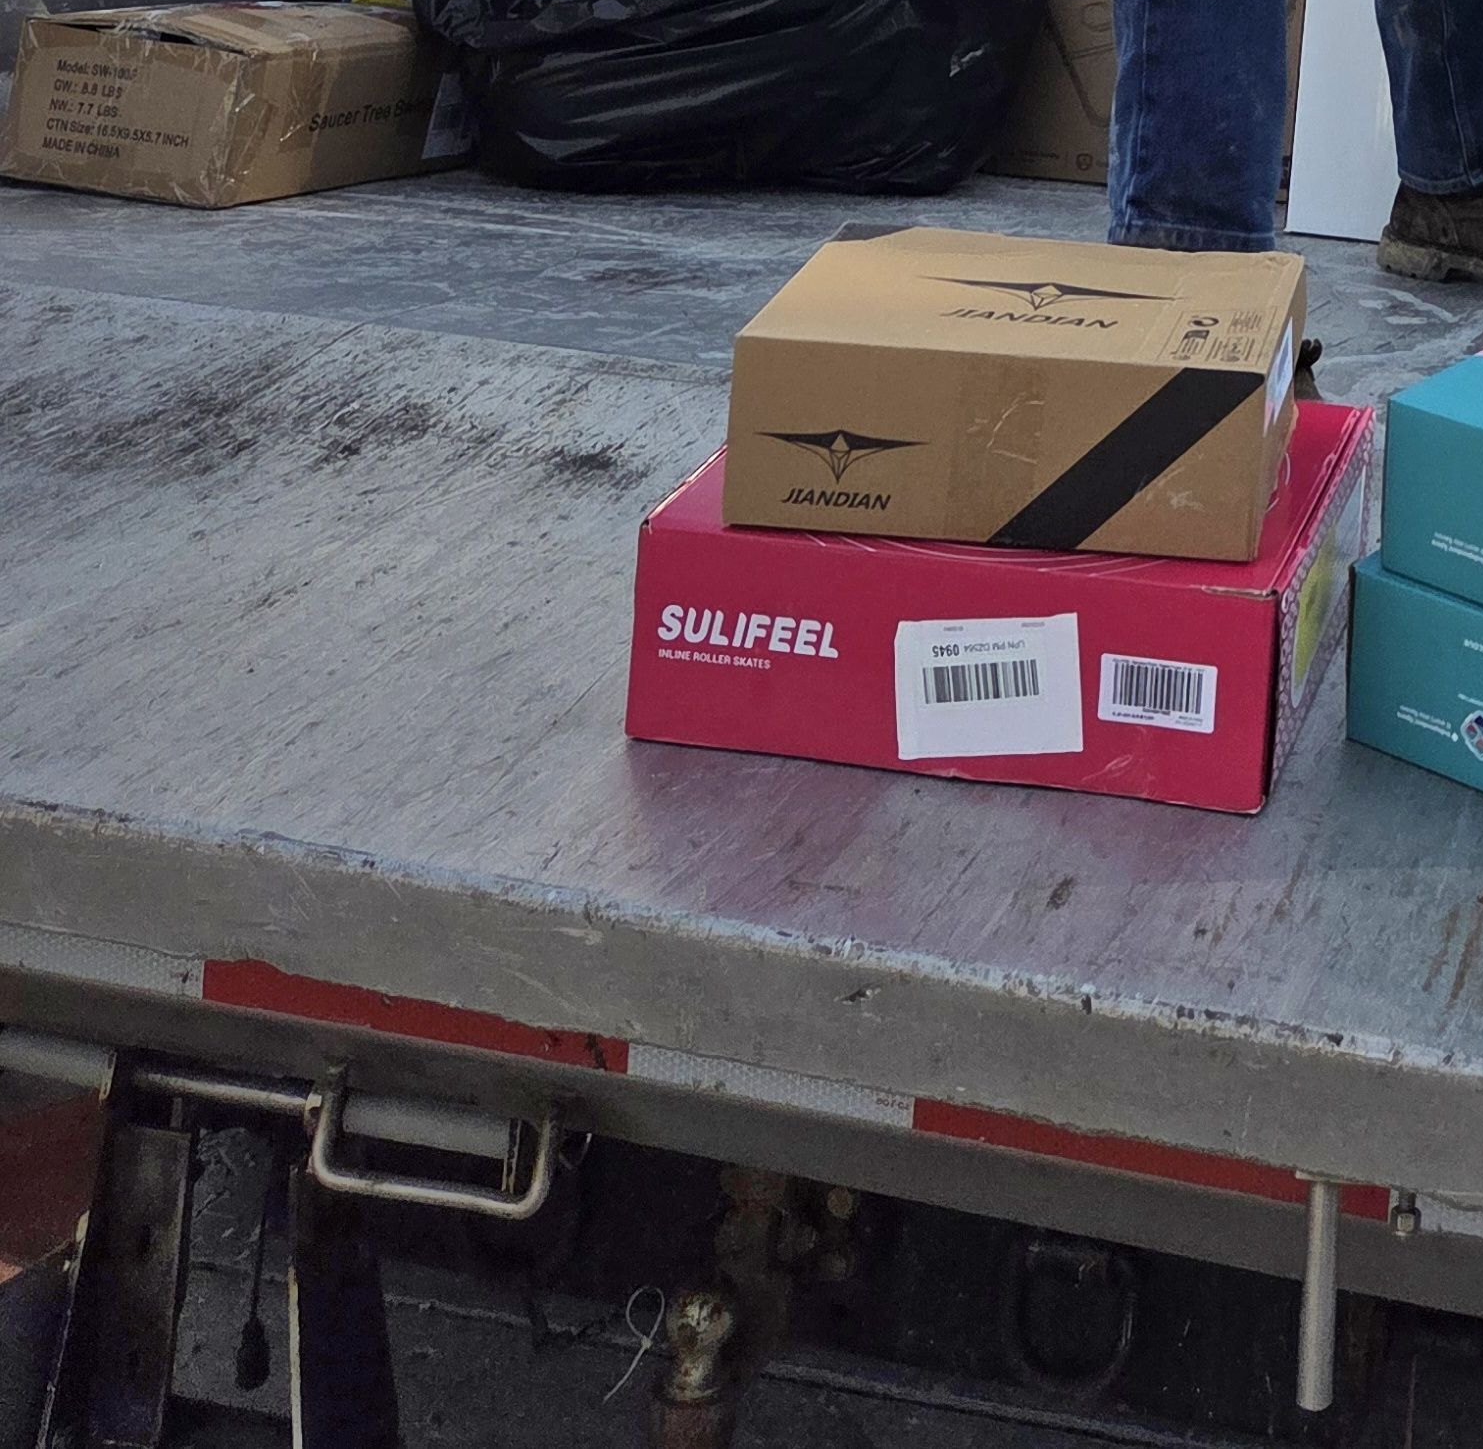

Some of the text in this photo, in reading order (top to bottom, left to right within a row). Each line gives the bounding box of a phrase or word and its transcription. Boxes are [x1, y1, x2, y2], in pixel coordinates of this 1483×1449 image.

[101, 85, 123, 100] LBS
[309, 111, 360, 132] Saucer
[363, 104, 391, 123] Tree
[42, 136, 74, 152] MADE
[88, 143, 120, 158] CHINA
[162, 133, 190, 148] INCH
[940, 308, 1119, 329] JIANDIAN
[782, 487, 892, 511] JIANDIAN
[657, 604, 839, 659] SULIFEEL
[658, 648, 771, 670] INLINE ROLLER SKATES
[932, 643, 960, 658] 0945
